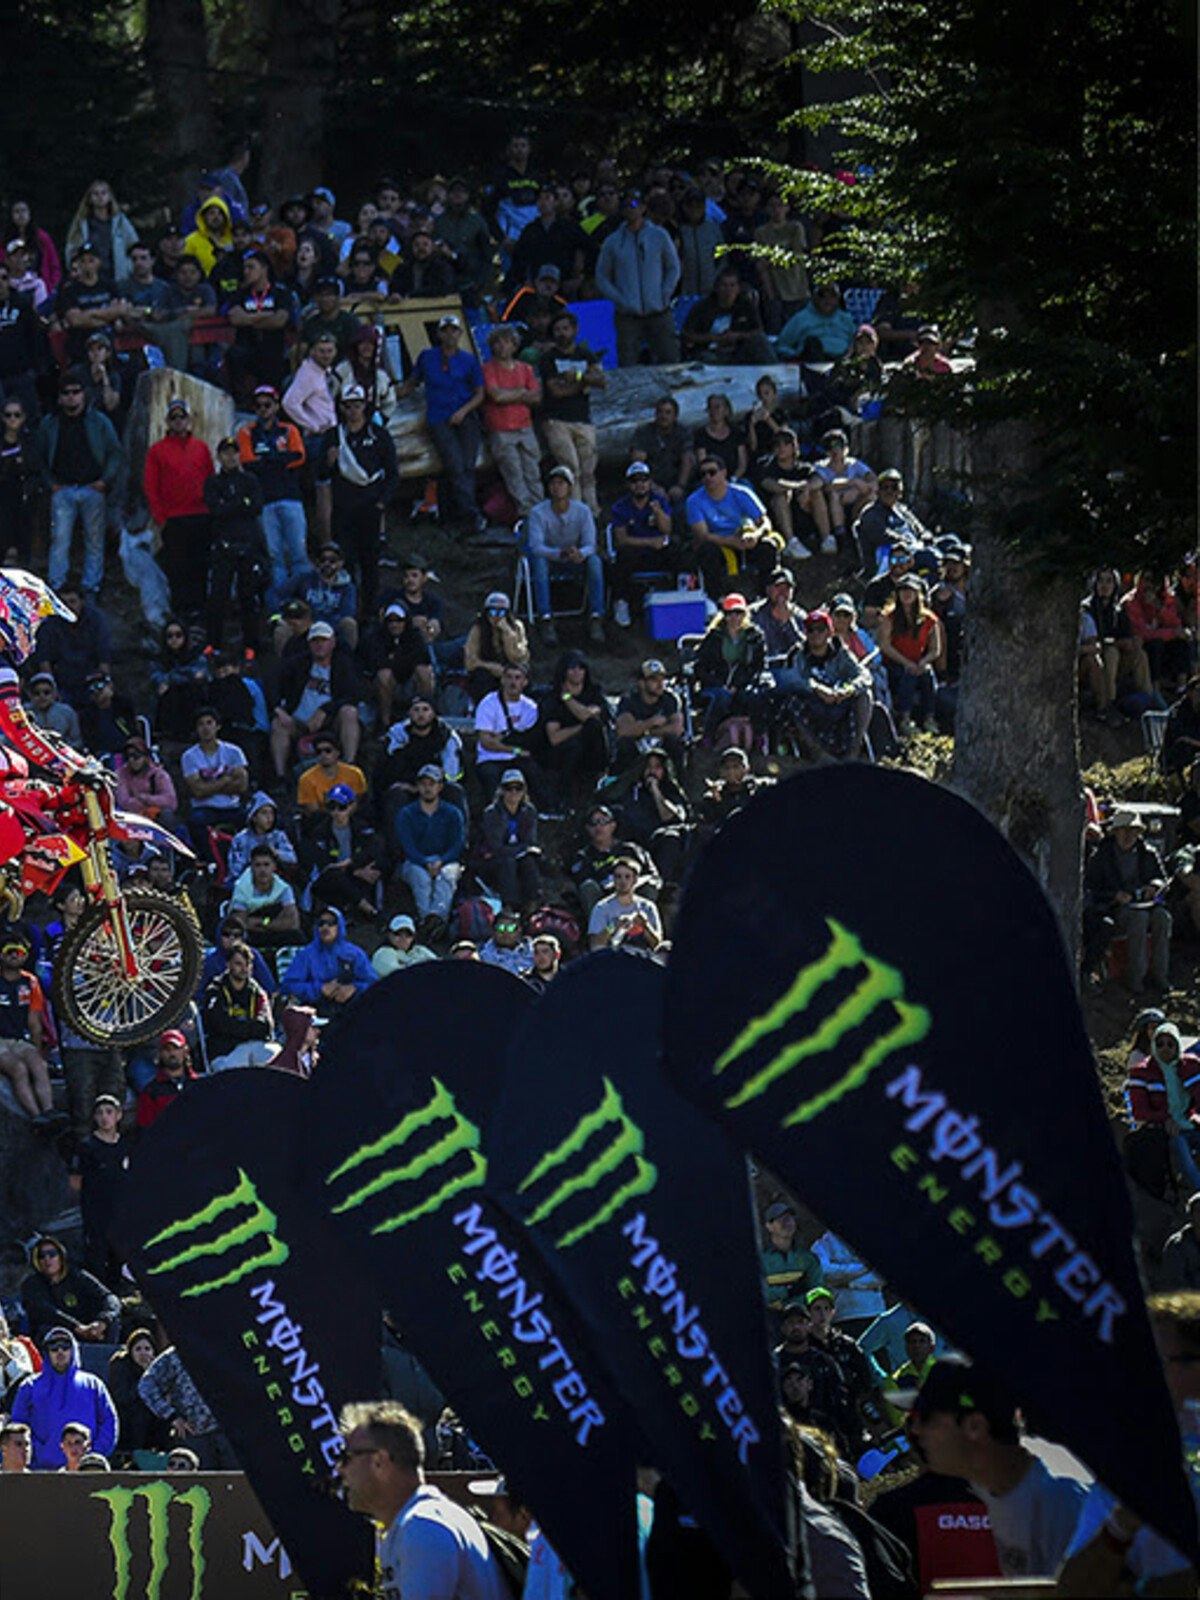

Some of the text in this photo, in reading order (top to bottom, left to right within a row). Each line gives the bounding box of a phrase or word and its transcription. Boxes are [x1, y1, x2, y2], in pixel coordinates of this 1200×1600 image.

[885, 1064, 1127, 1343] MONSTER
[890, 1144, 1059, 1322] ENERGY
[241, 1329, 316, 1475] ENERGY
[250, 1279, 347, 1478] MONSTE
[447, 1263, 549, 1420] ENERGY
[452, 1202, 606, 1446] MONSTER
[617, 1276, 717, 1440] ENERGY
[622, 1211, 760, 1465] MONSTER
